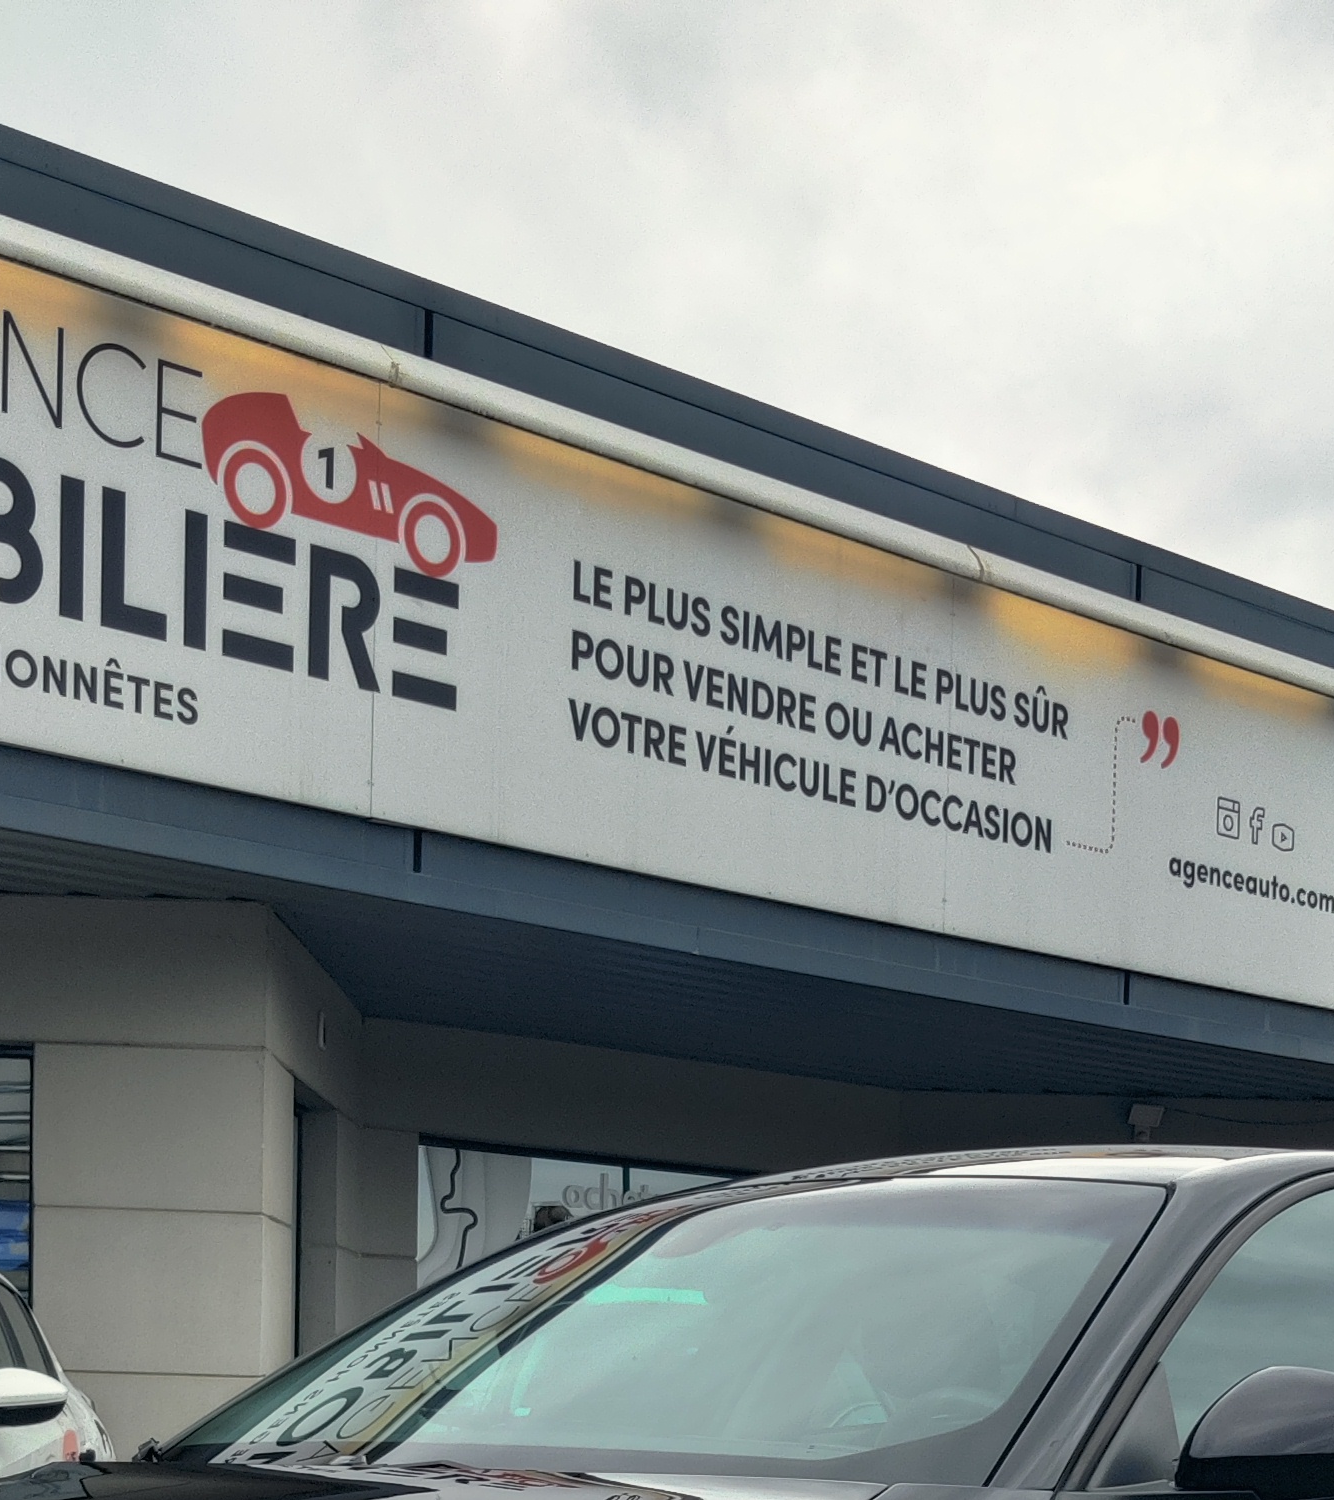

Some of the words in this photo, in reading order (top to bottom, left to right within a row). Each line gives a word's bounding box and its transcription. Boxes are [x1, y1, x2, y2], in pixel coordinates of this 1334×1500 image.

[570, 628, 675, 698] POUR
[682, 659, 817, 734] VENDRE
[824, 700, 873, 747] OU
[878, 715, 1018, 786] ACHETER
[572, 559, 614, 611] LE
[624, 574, 711, 638] PLUS
[719, 604, 842, 677] SIMPLE
[850, 642, 888, 688] ET
[893, 655, 927, 701] LE
[935, 667, 1007, 723] PLUS
[1013, 685, 1069, 741] SÛR
[567, 697, 688, 767] VOTRE
[694, 724, 857, 808] VÉHICULE
[864, 773, 1053, 855] D'OCCASION
